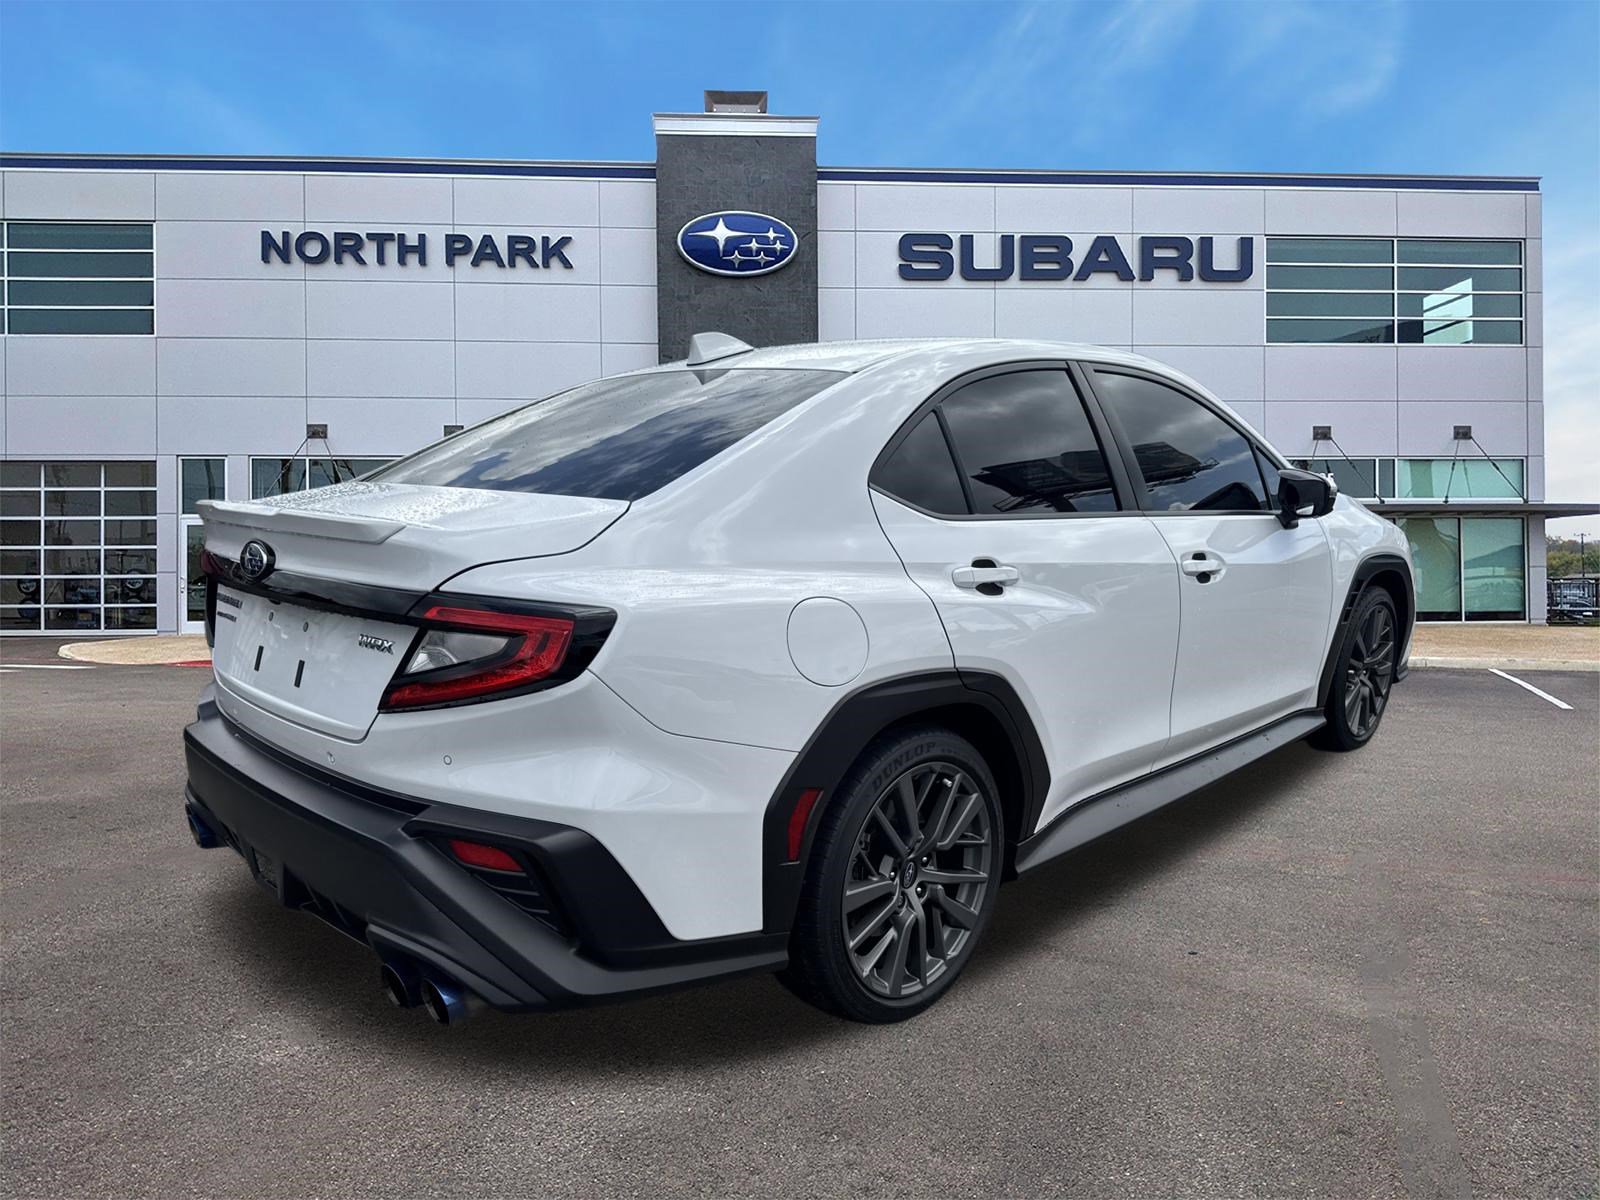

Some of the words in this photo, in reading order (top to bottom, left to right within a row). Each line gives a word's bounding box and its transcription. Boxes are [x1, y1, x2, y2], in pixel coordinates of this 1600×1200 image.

[260, 230, 427, 267] NORTH
[444, 233, 574, 270] PARK
[898, 233, 1254, 283] SUBARU
[358, 633, 395, 656] WRX
[872, 741, 937, 789] DUNLOP
